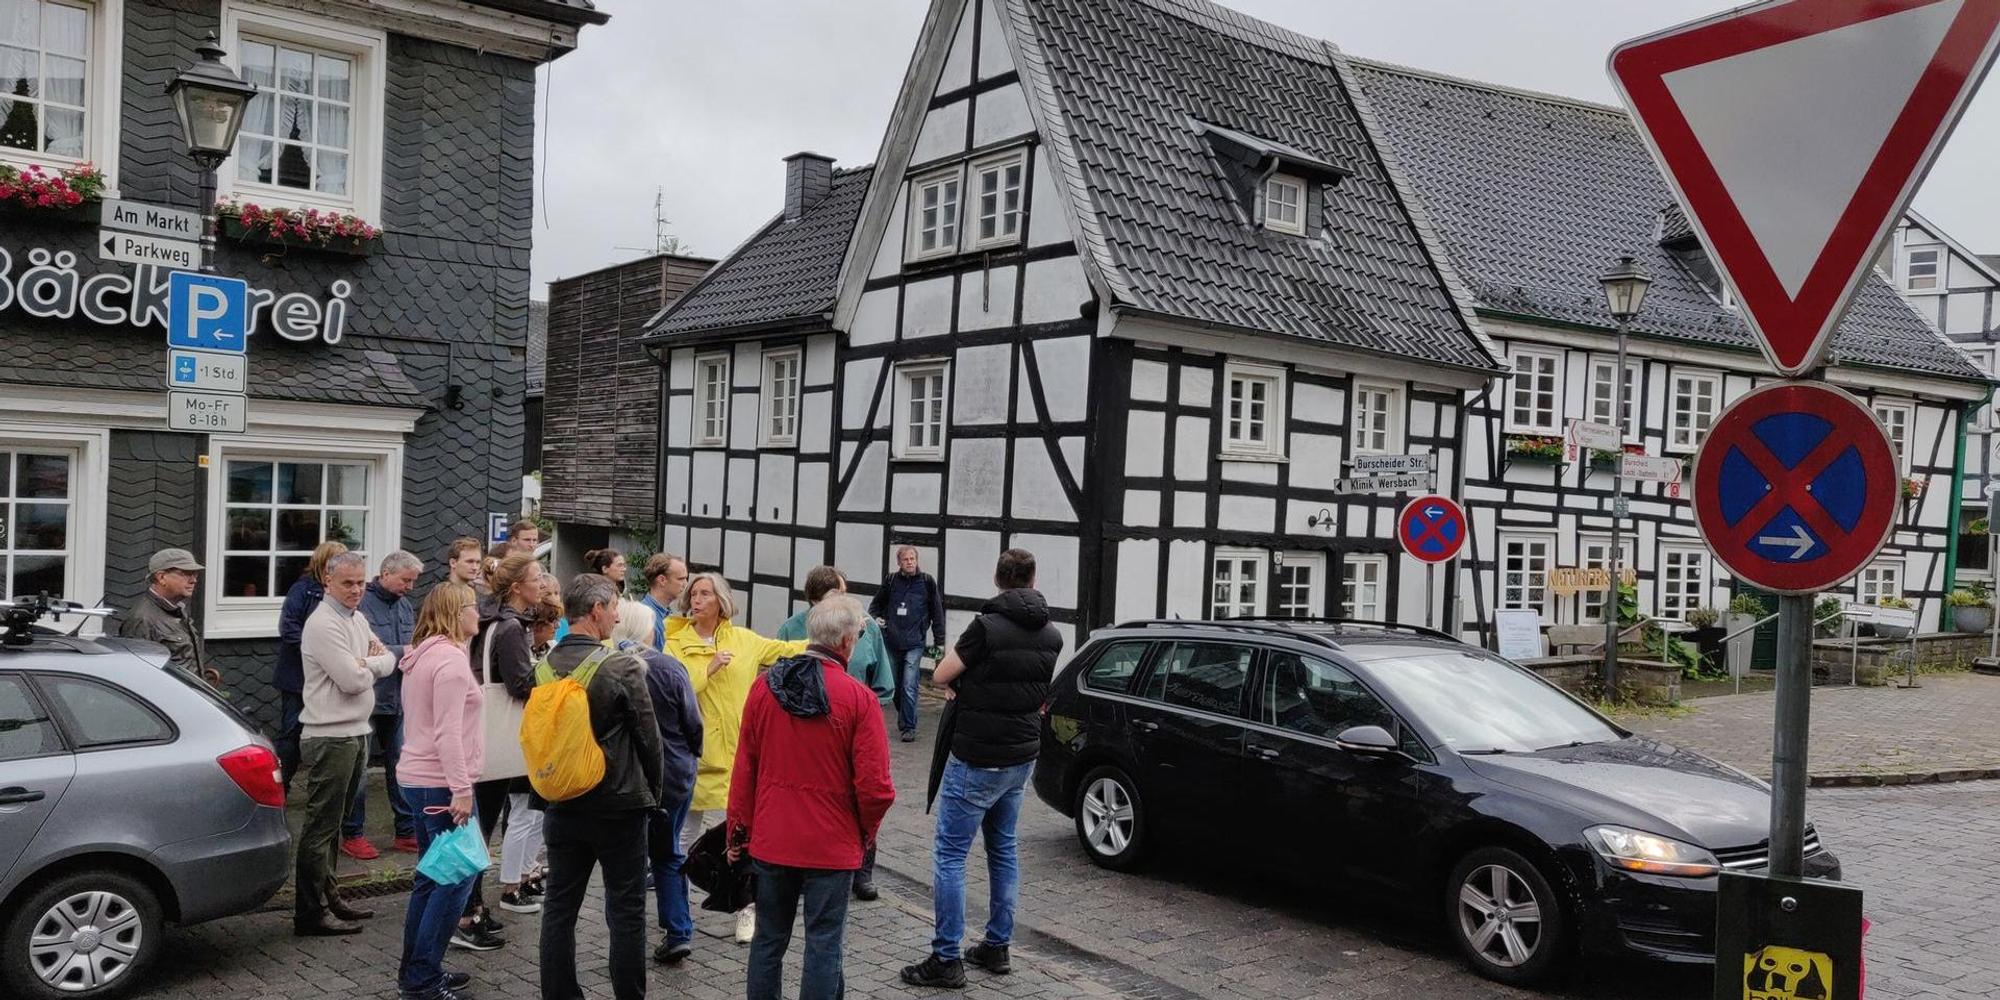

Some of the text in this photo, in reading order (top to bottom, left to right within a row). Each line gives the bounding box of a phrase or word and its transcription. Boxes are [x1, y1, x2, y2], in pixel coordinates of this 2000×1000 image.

[114, 205, 189, 233] Am Markt
[125, 239, 190, 267] Parkweg
[0, 247, 351, 345] äckrei
[187, 284, 229, 339] P
[186, 398, 230, 412] Mo-Fr
[1357, 457, 1424, 469] Burscheider Str.
[1351, 476, 1418, 490] Klinik Wersbach
